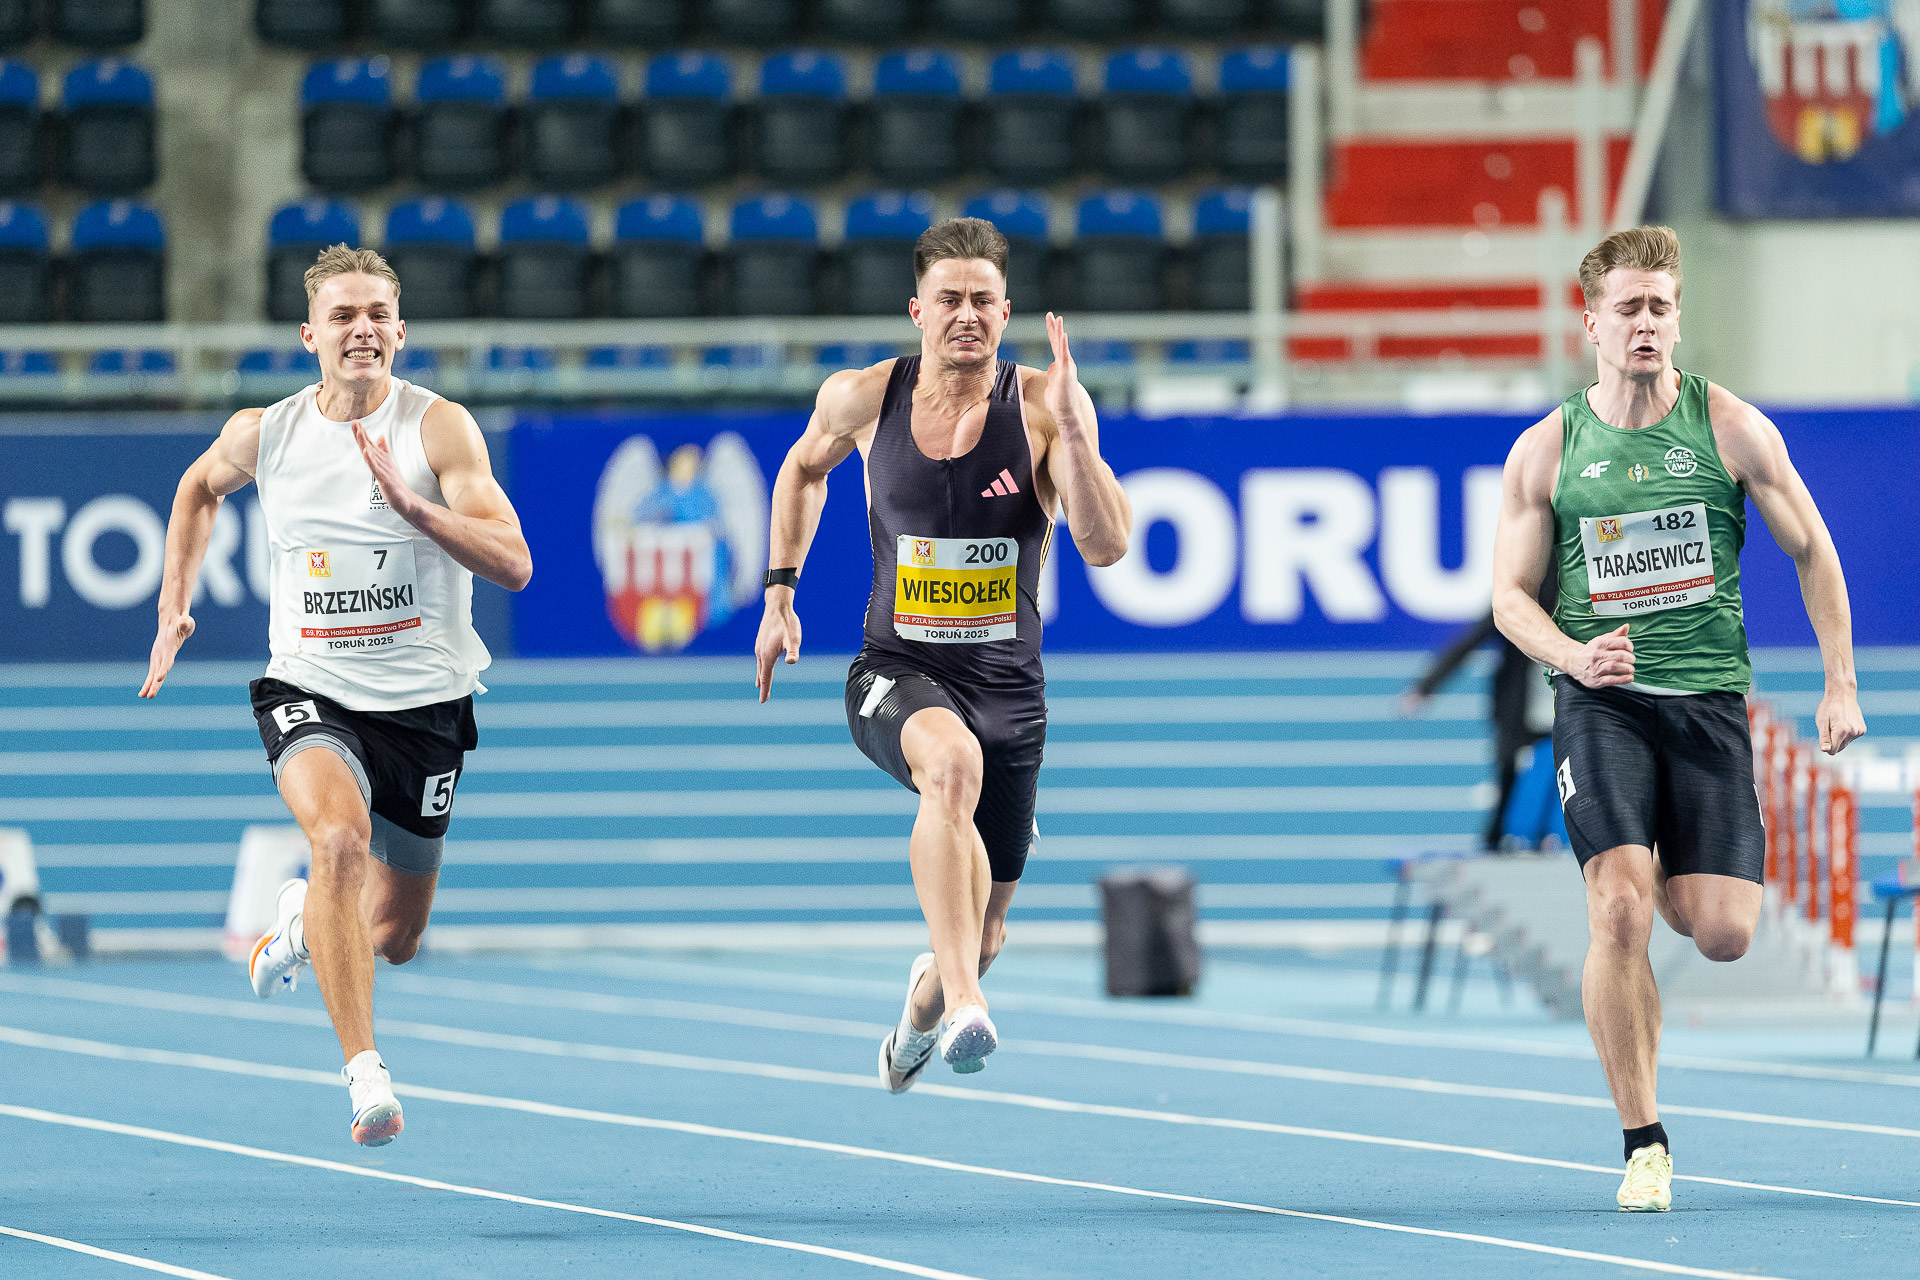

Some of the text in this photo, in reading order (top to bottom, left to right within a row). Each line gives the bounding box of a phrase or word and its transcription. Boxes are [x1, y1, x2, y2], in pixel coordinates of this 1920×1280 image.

[1671, 451, 1690, 459] AZS
[1579, 460, 1611, 479] 4F
[1671, 461, 1692, 471] AWF
[1651, 510, 1696, 531] 182
[373, 549, 388, 570] 7
[964, 542, 1008, 564] 200
[1592, 541, 1706, 579] TARASIEWICZ
[902, 577, 1011, 604] WIESIOŁEK
[1624, 588, 1650, 597] Halowe
[1651, 582, 1690, 593] Mistrzostwa
[1691, 576, 1711, 585] Polski
[303, 583, 414, 614] BRZEZIŃSKI
[1622, 592, 1688, 610] TORUŃ 2025
[315, 629, 329, 637] PZLA
[330, 628, 356, 636] Halowe
[356, 626, 397, 634] Mistrzostwa
[397, 619, 417, 629] Polski
[954, 618, 993, 626] Mistrzostwa
[994, 614, 1012, 622] Polski
[327, 635, 394, 650] TORUŃ 2025
[924, 628, 989, 639] TORUŃ 2025
[284, 704, 311, 724] 5
[431, 774, 452, 812] 5
